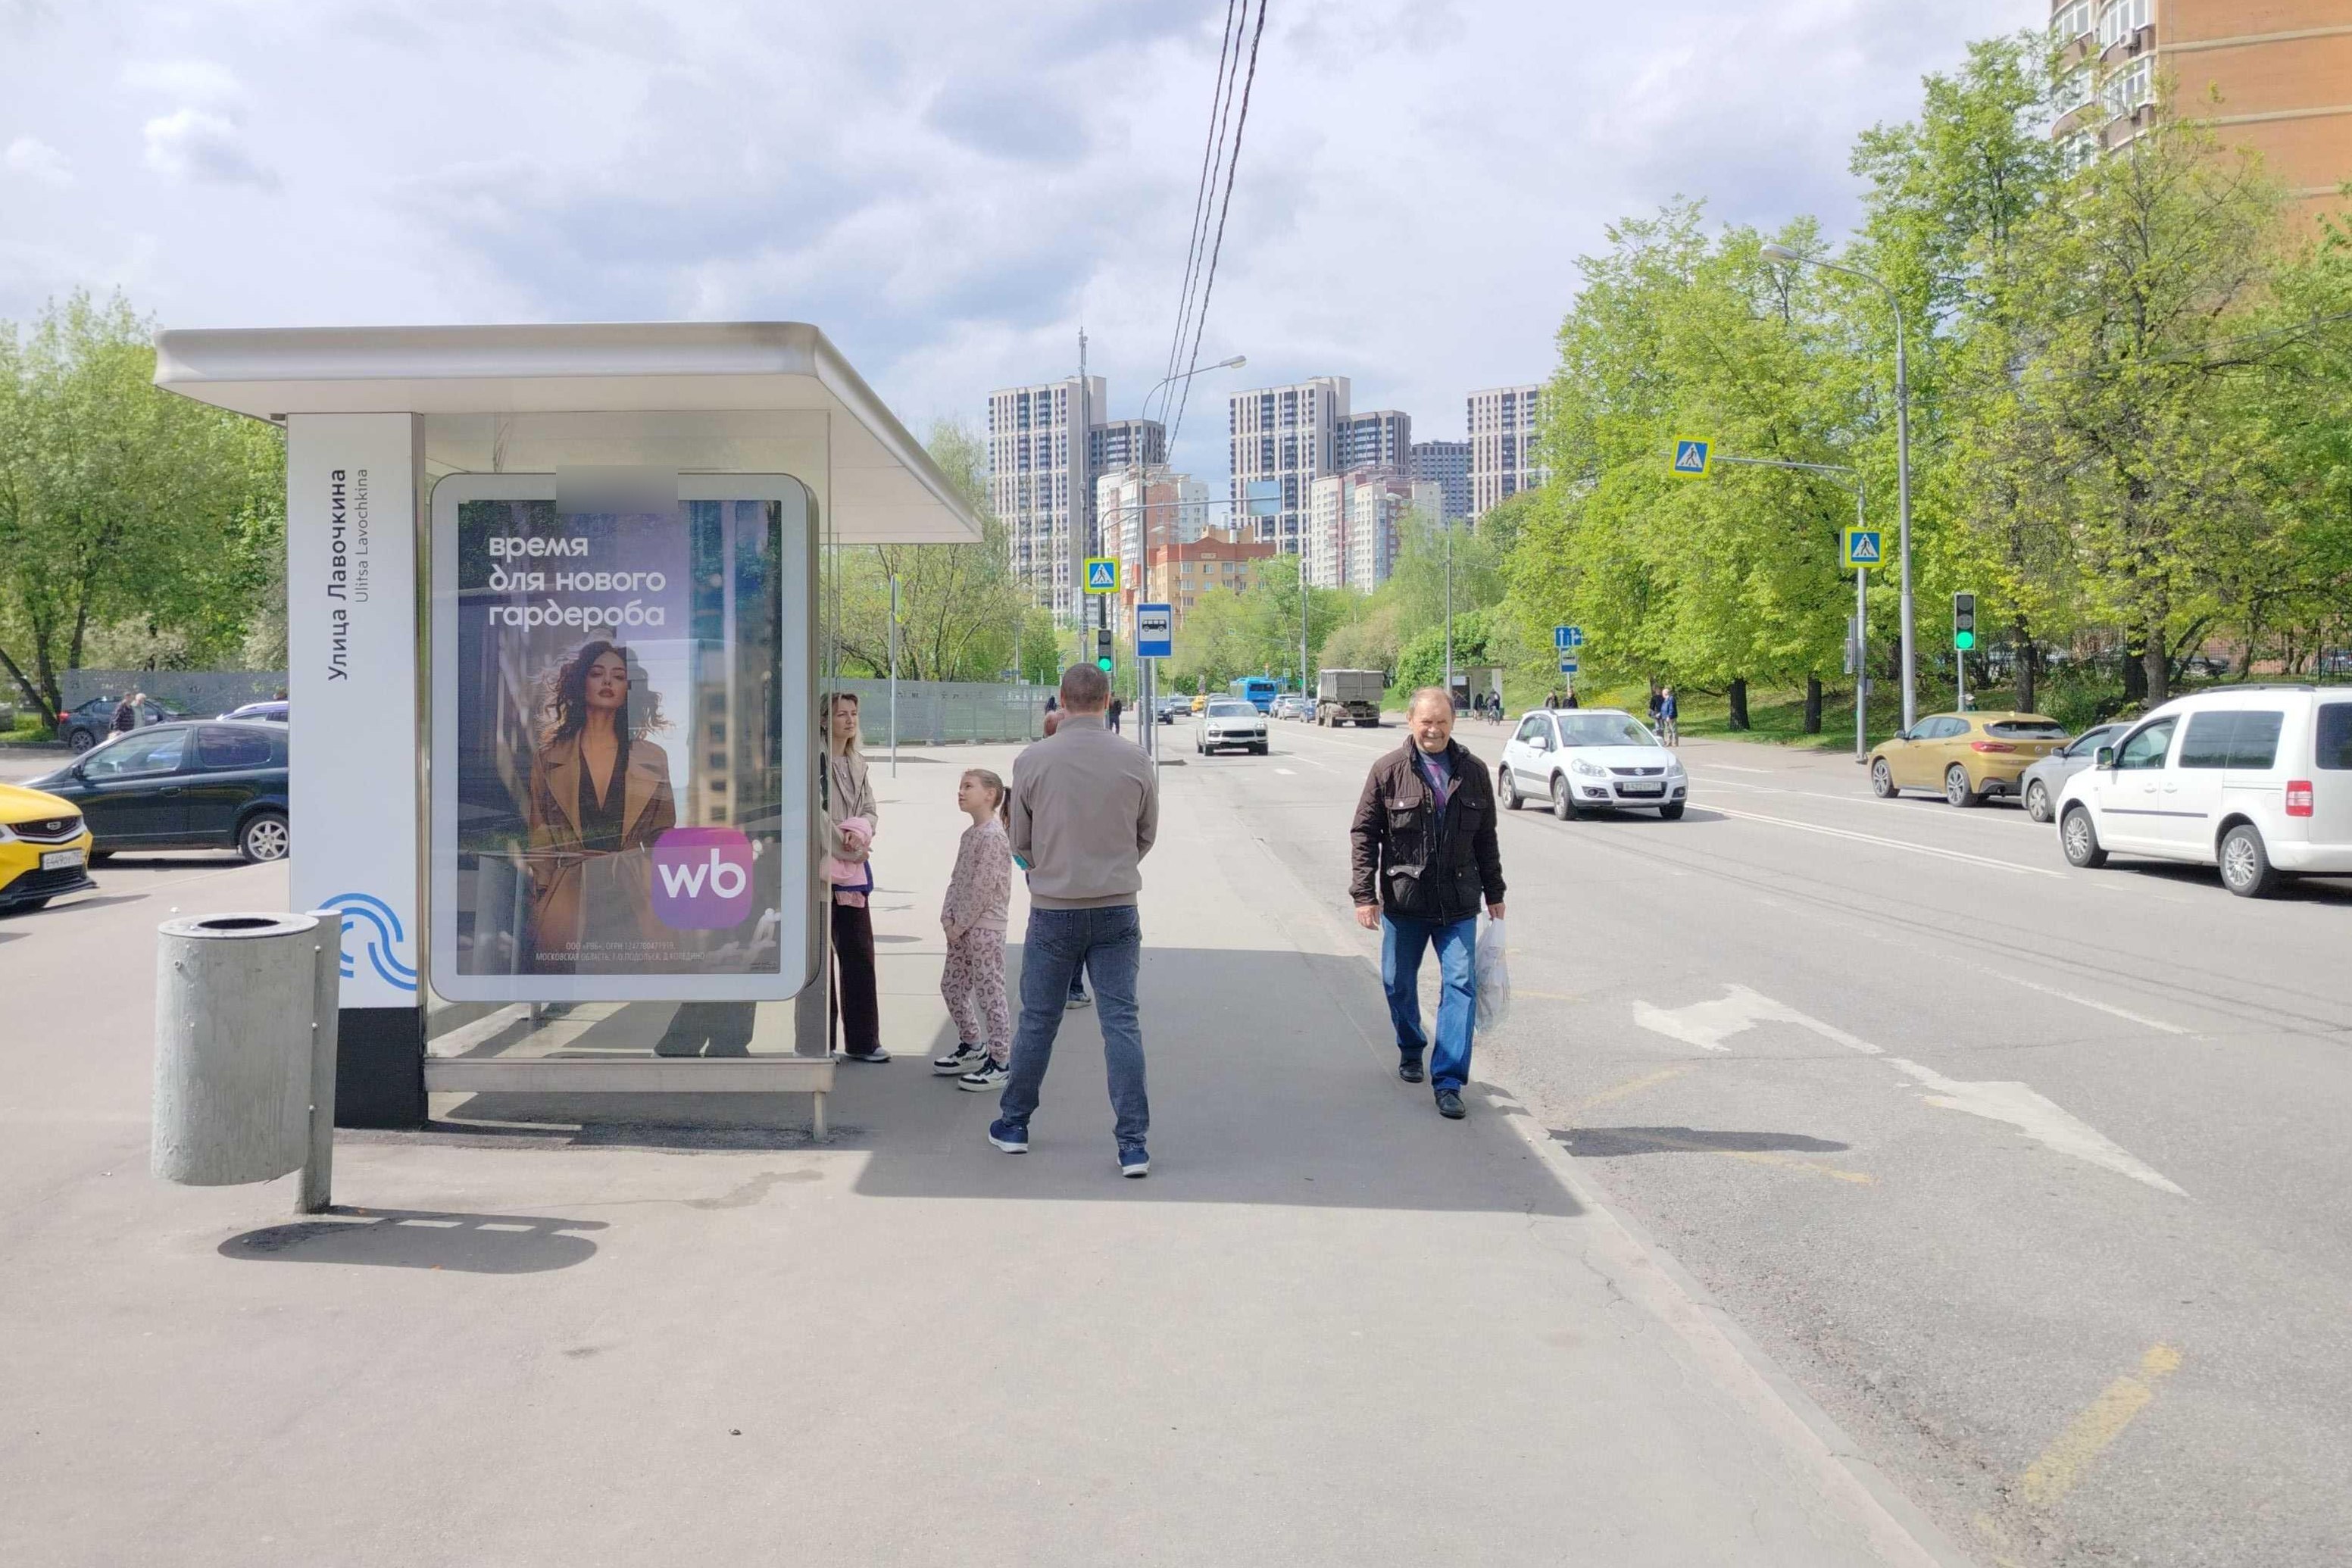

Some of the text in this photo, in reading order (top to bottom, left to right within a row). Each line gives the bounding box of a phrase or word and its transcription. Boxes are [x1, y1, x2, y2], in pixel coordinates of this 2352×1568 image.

[355, 469, 368, 602] Ulitsa Lavochkina
[489, 537, 589, 563] время
[327, 469, 349, 680] Улица Лавочкина
[489, 564, 666, 592] для нового
[489, 599, 665, 633] гардероба
[657, 848, 747, 899] wb
[535, 952, 579, 961] МОСКОВСКАЯ
[566, 942, 581, 951] ООО
